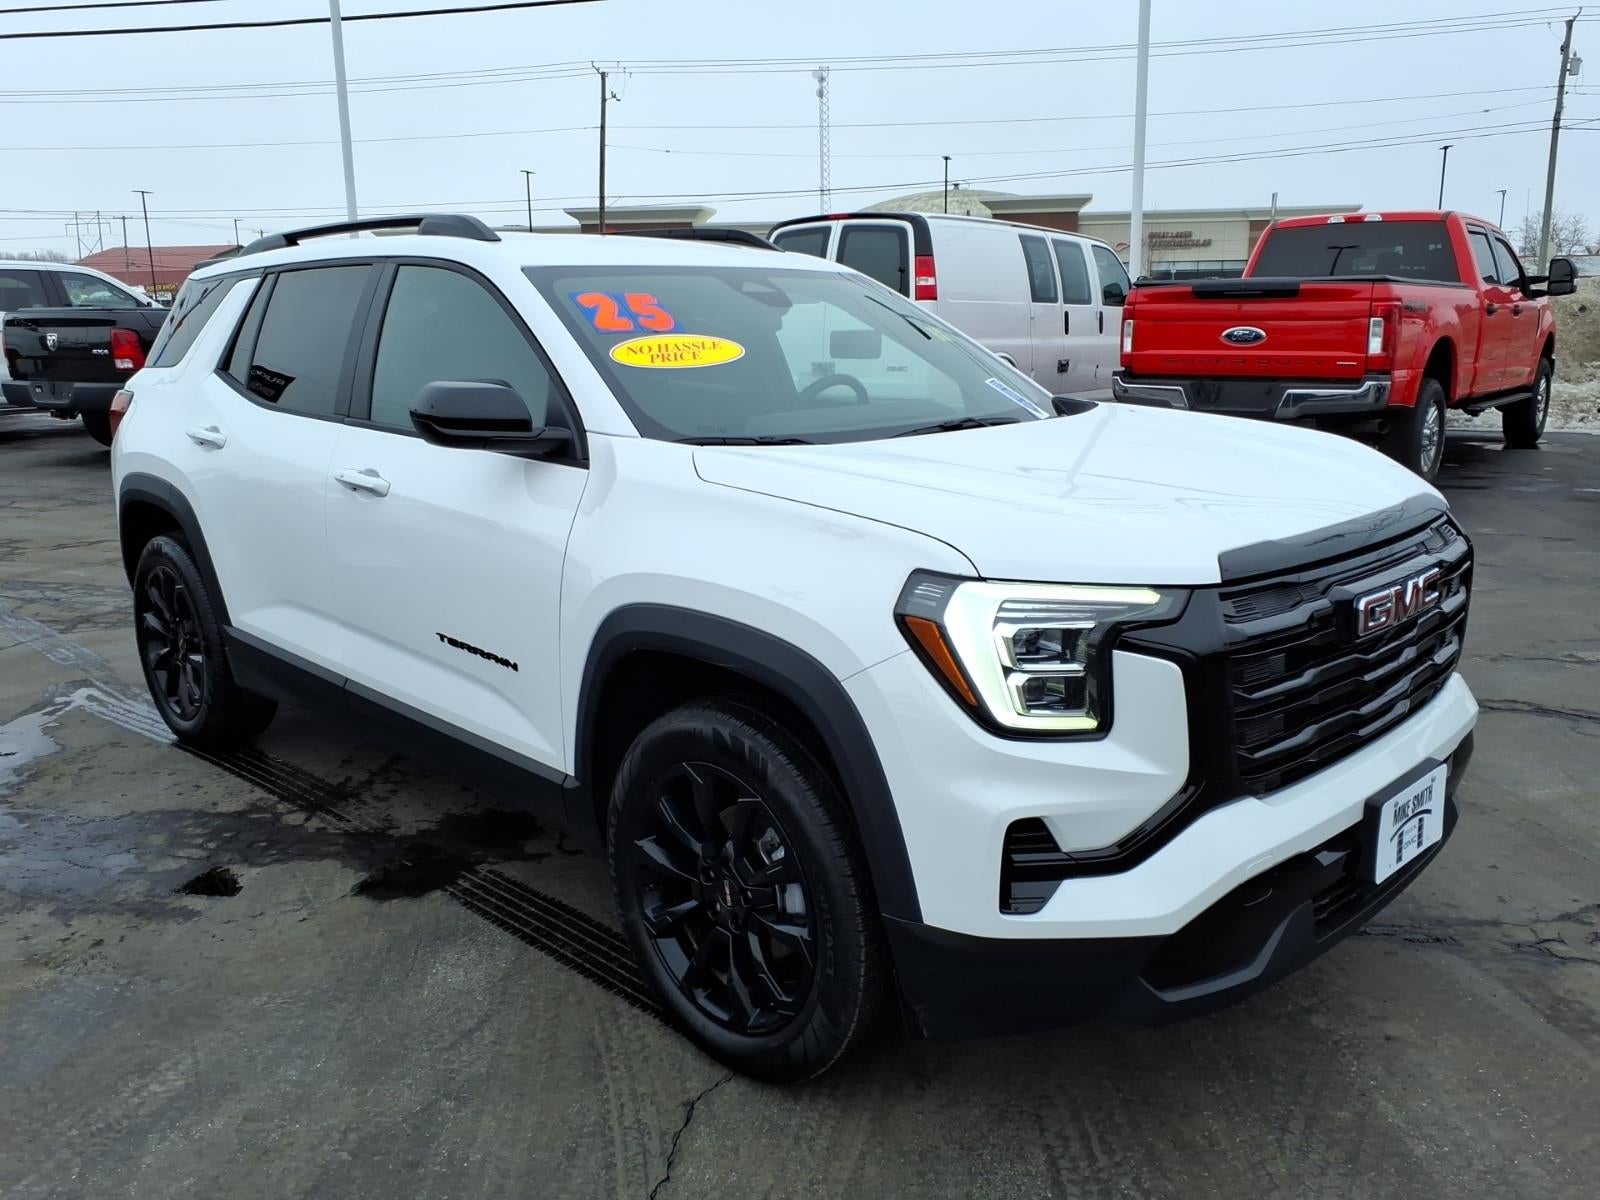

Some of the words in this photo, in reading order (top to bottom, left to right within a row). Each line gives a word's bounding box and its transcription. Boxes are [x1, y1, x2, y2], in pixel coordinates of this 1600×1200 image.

[576, 292, 675, 331] 25
[627, 344, 651, 356] NO
[658, 340, 722, 352] HASSLE
[1231, 329, 1256, 341] Ford
[651, 351, 702, 363] PRICE
[1165, 358, 1248, 366] SUPER
[1359, 567, 1440, 636] GMC
[435, 632, 519, 672] TERRAIN
[1393, 800, 1411, 827] MIKE
[1411, 784, 1433, 813] SMITH
